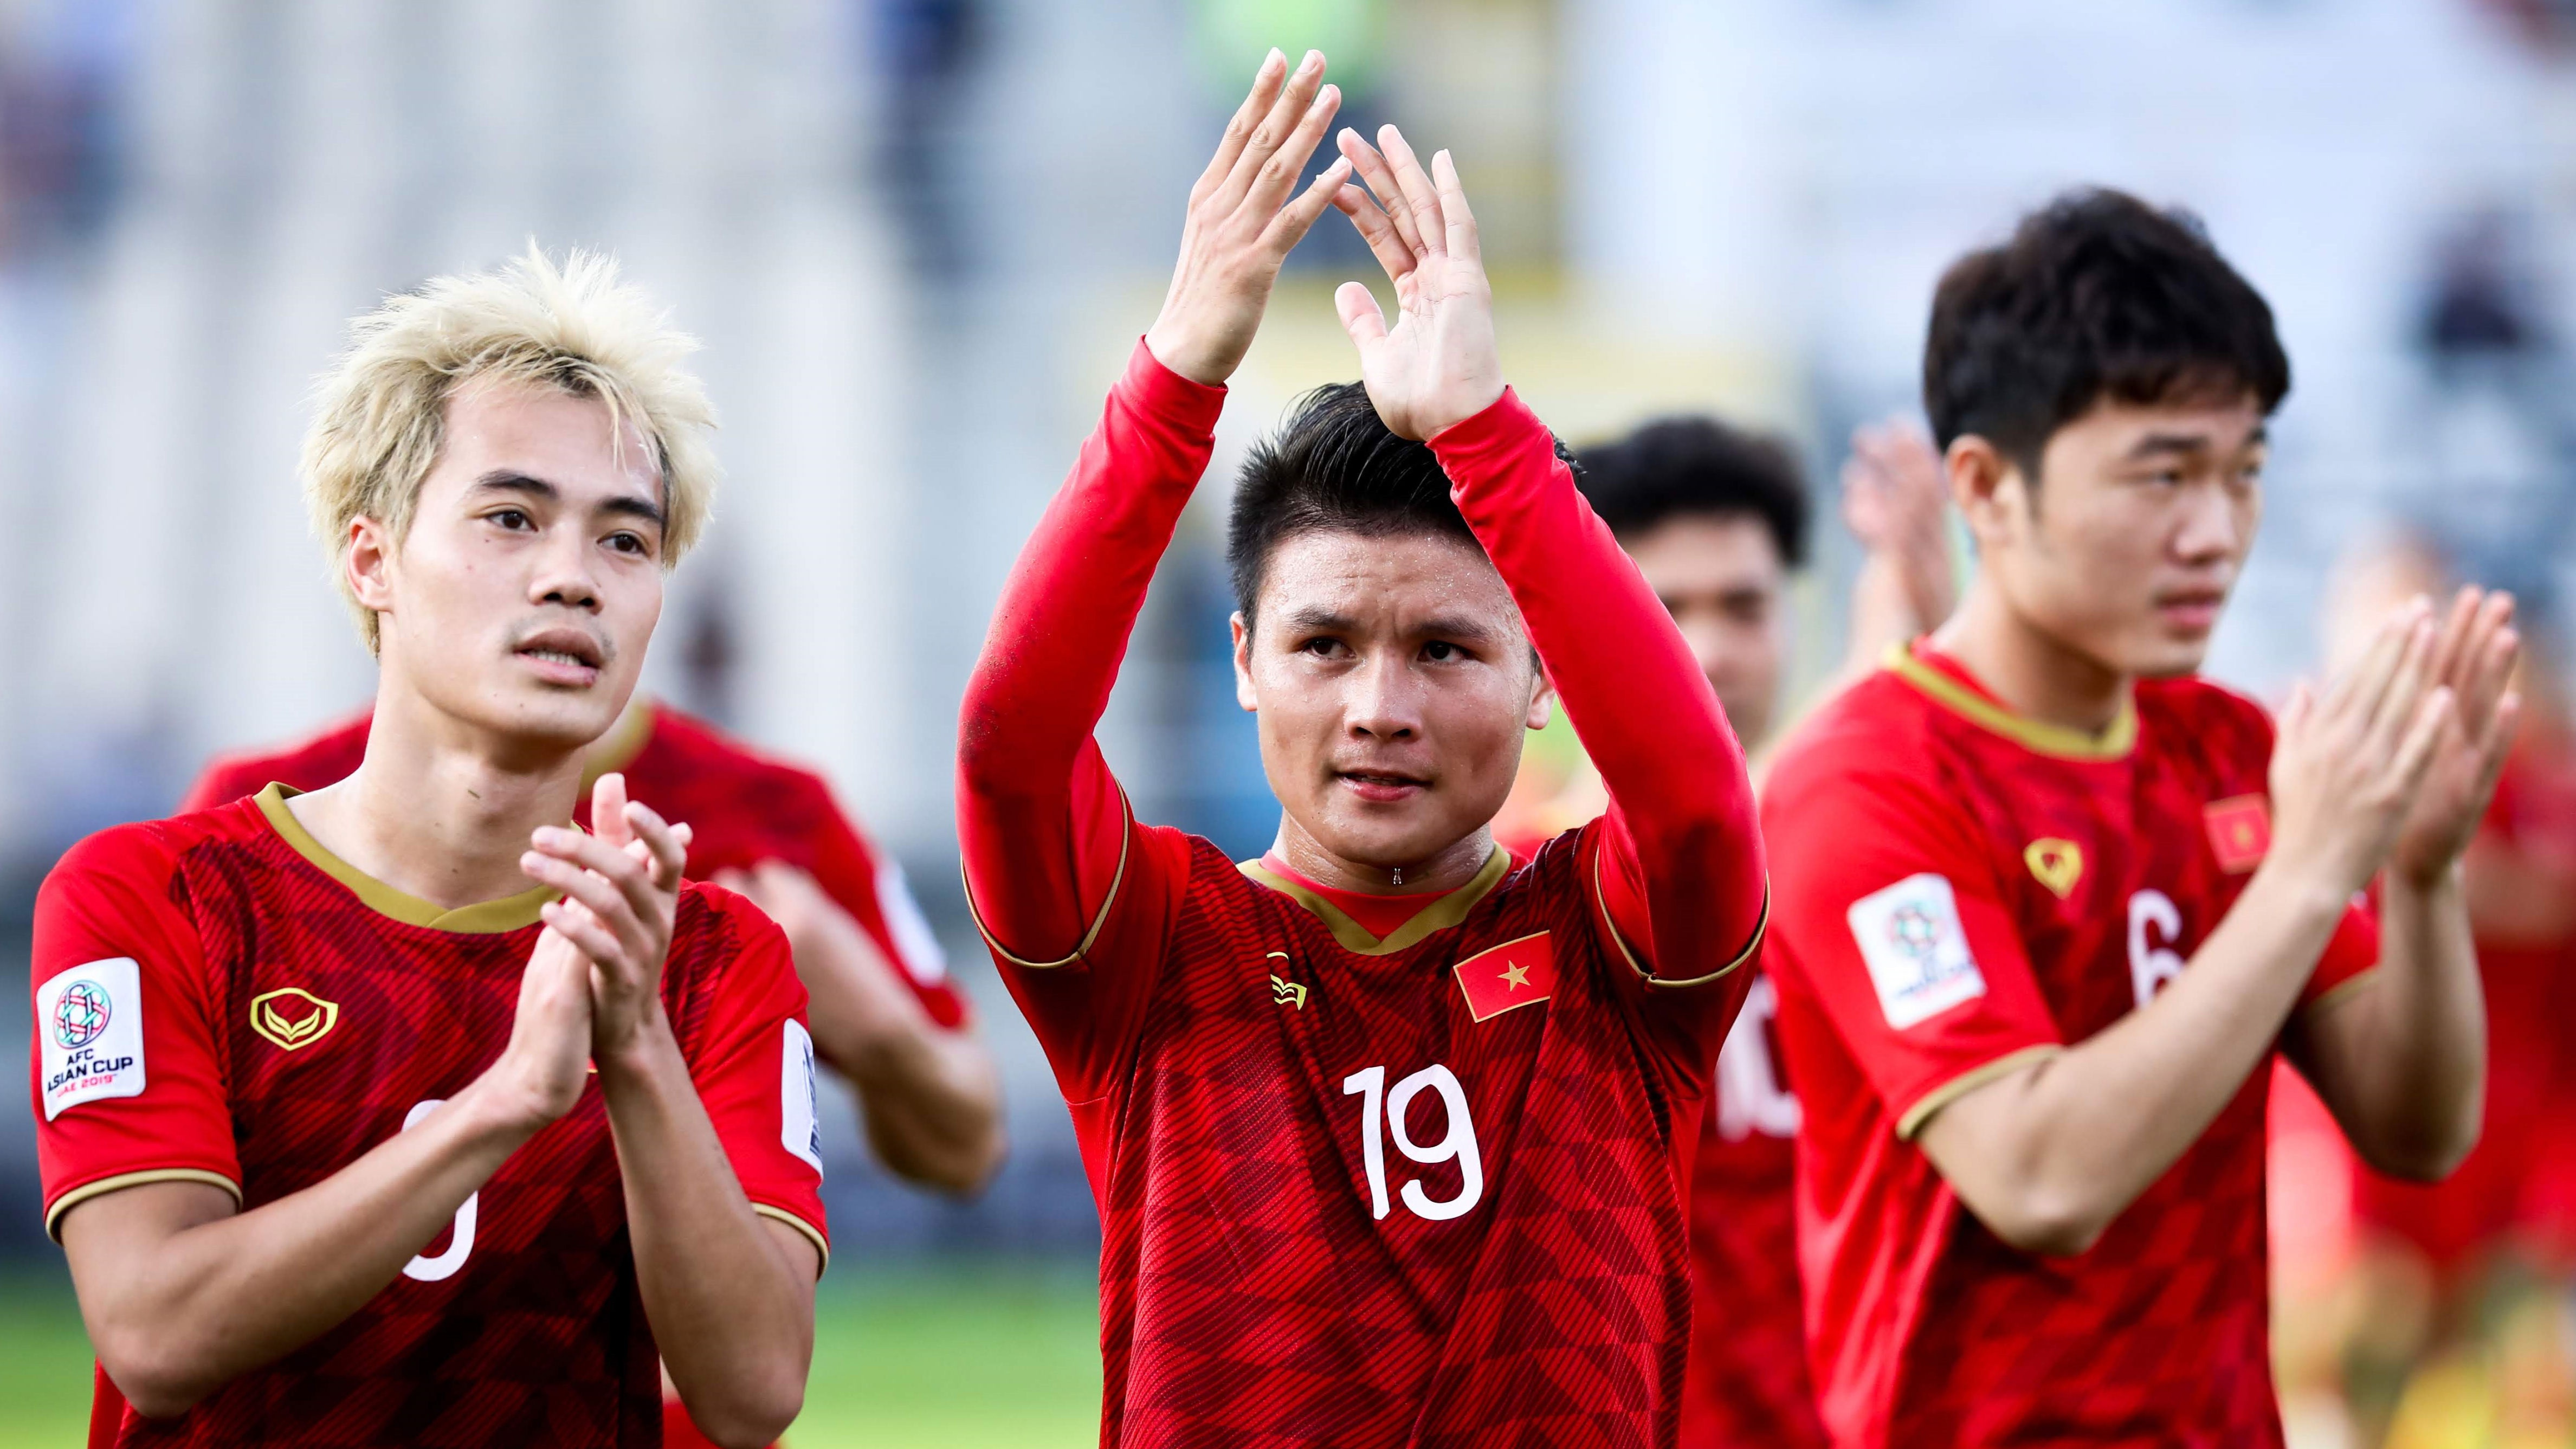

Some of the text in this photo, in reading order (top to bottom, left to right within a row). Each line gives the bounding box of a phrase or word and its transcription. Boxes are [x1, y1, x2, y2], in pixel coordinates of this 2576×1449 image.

[2128, 888, 2184, 1009] 6
[67, 1048, 94, 1066] AFC
[93, 1057, 133, 1073] CUP
[82, 1074, 113, 1088] 2019
[1344, 1064, 1483, 1220] 19
